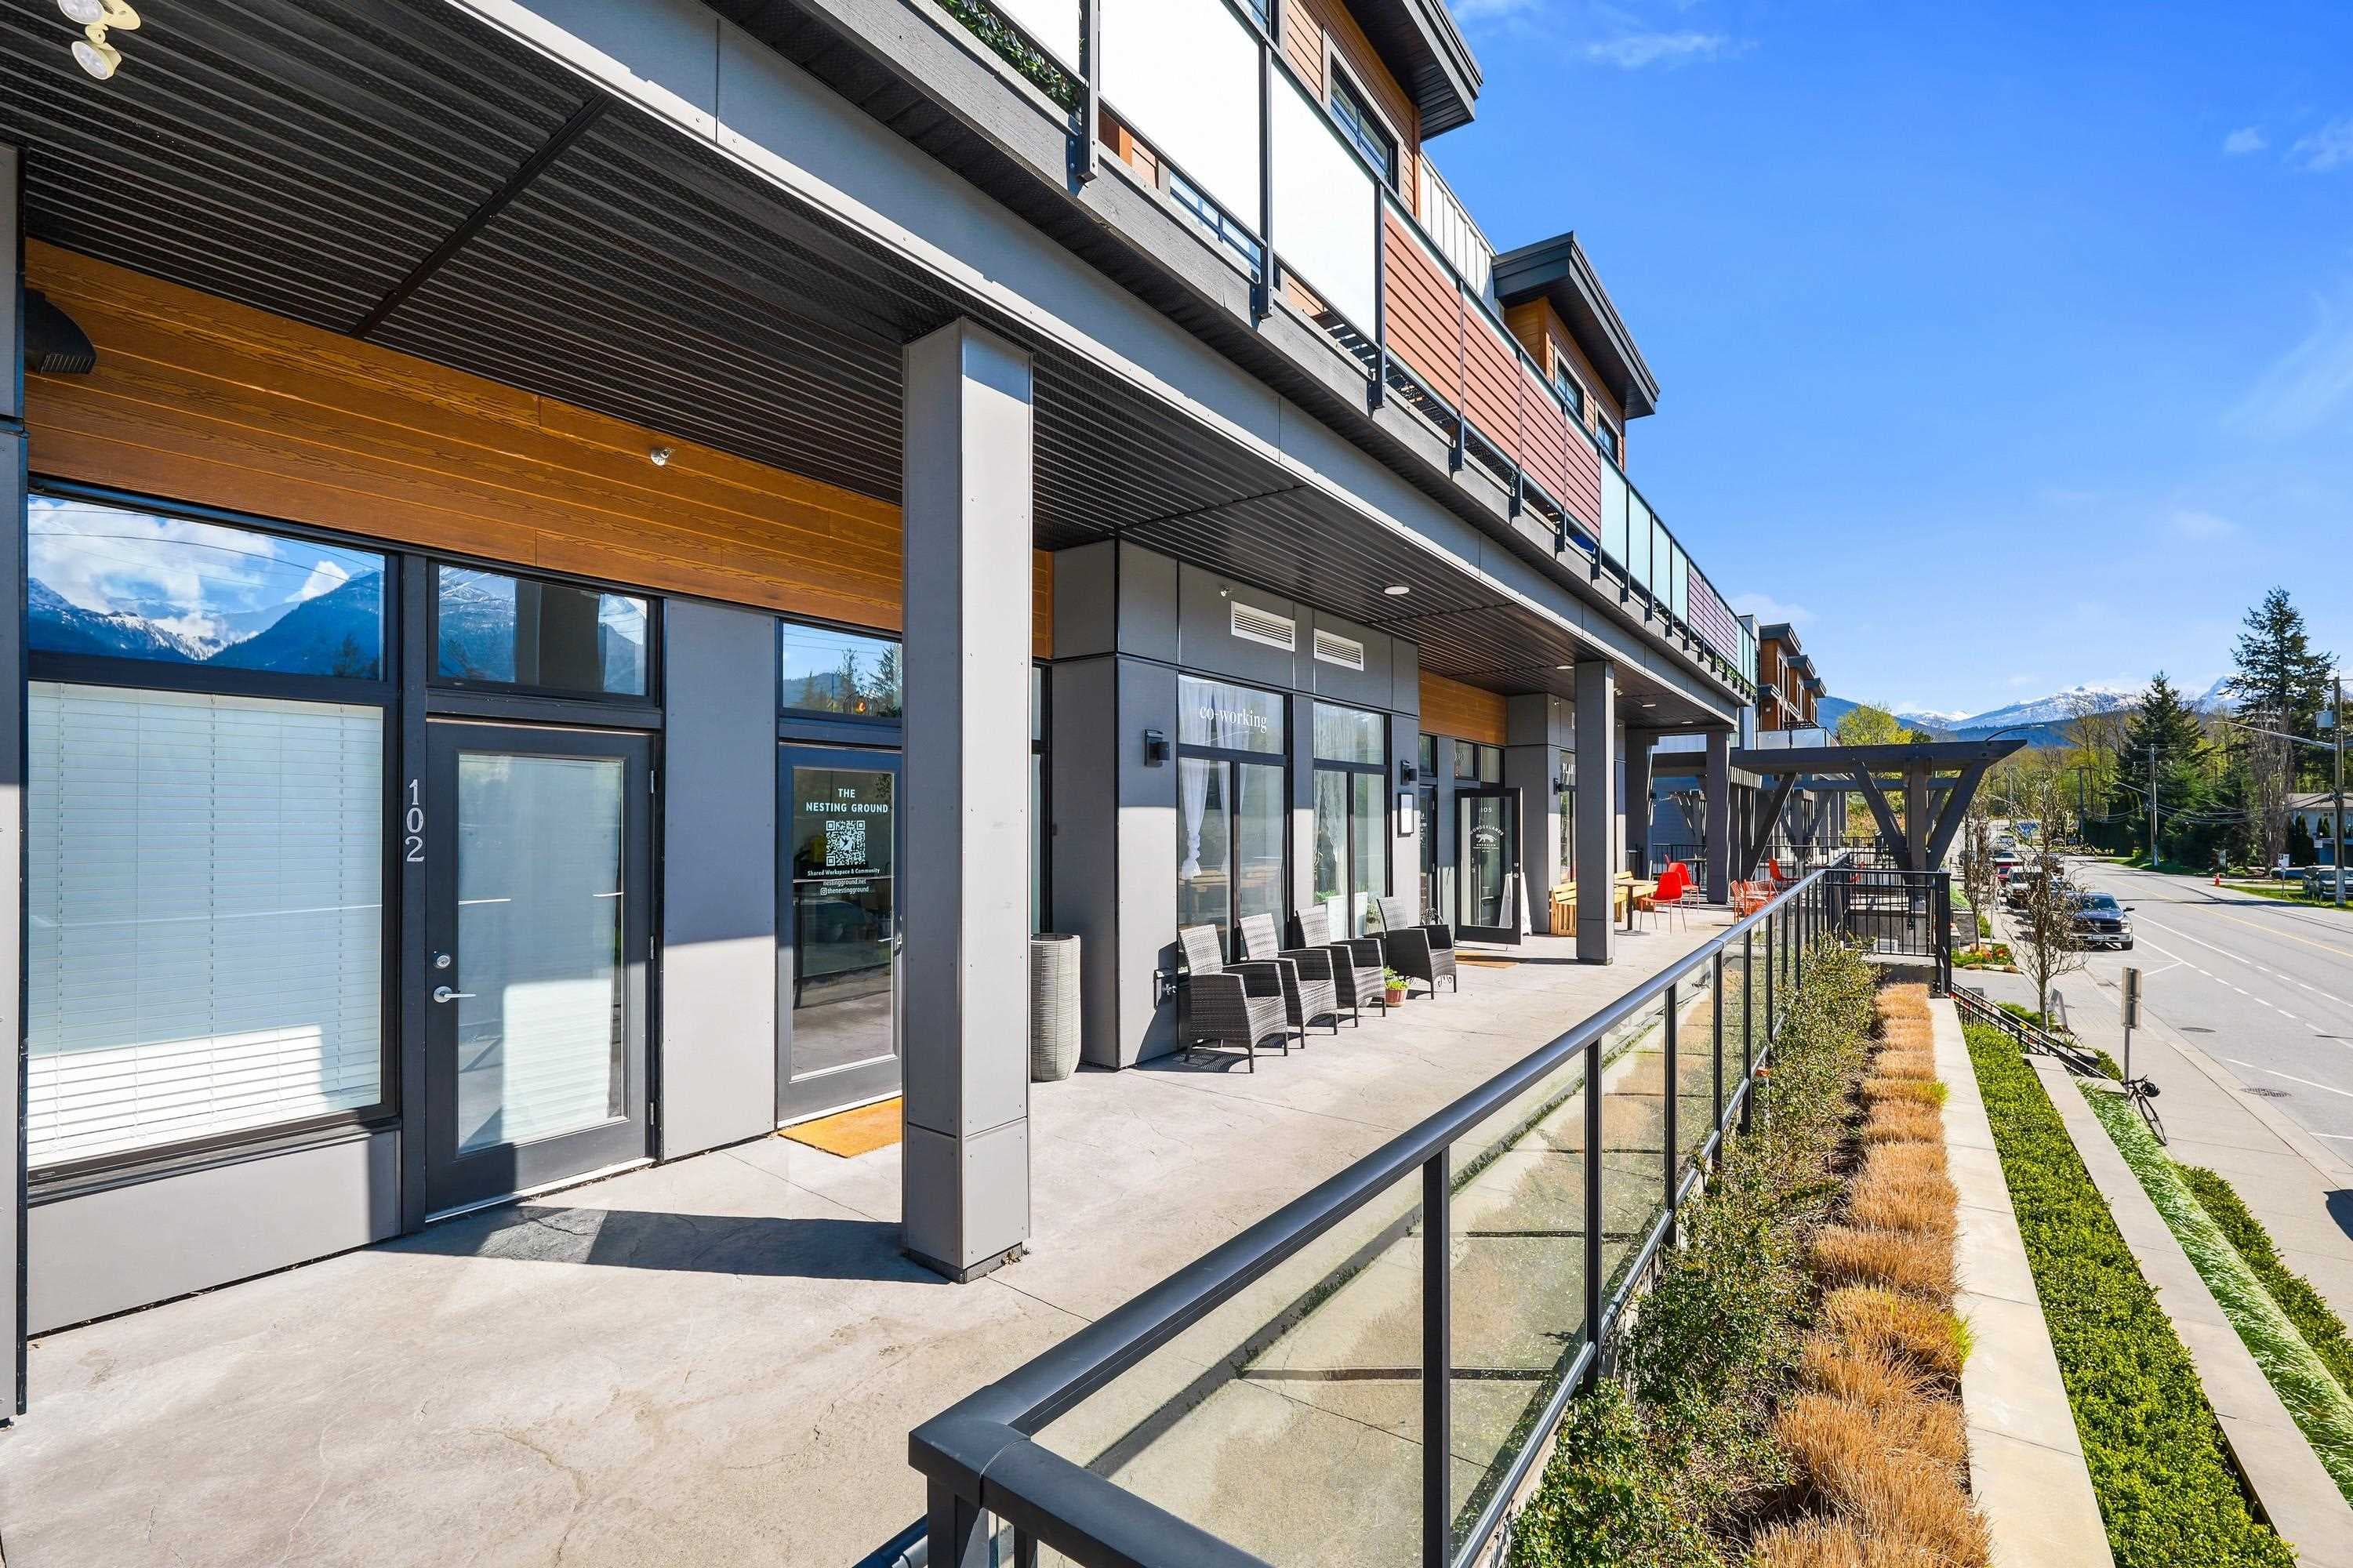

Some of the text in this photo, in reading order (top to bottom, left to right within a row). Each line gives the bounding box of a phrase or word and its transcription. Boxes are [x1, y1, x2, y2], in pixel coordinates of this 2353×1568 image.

[1200, 706, 1268, 734] co-working
[837, 788, 855, 798] THE
[806, 802, 888, 813] NESTING GROUND
[405, 779, 425, 862] 102
[827, 886, 870, 895] thenestingground
